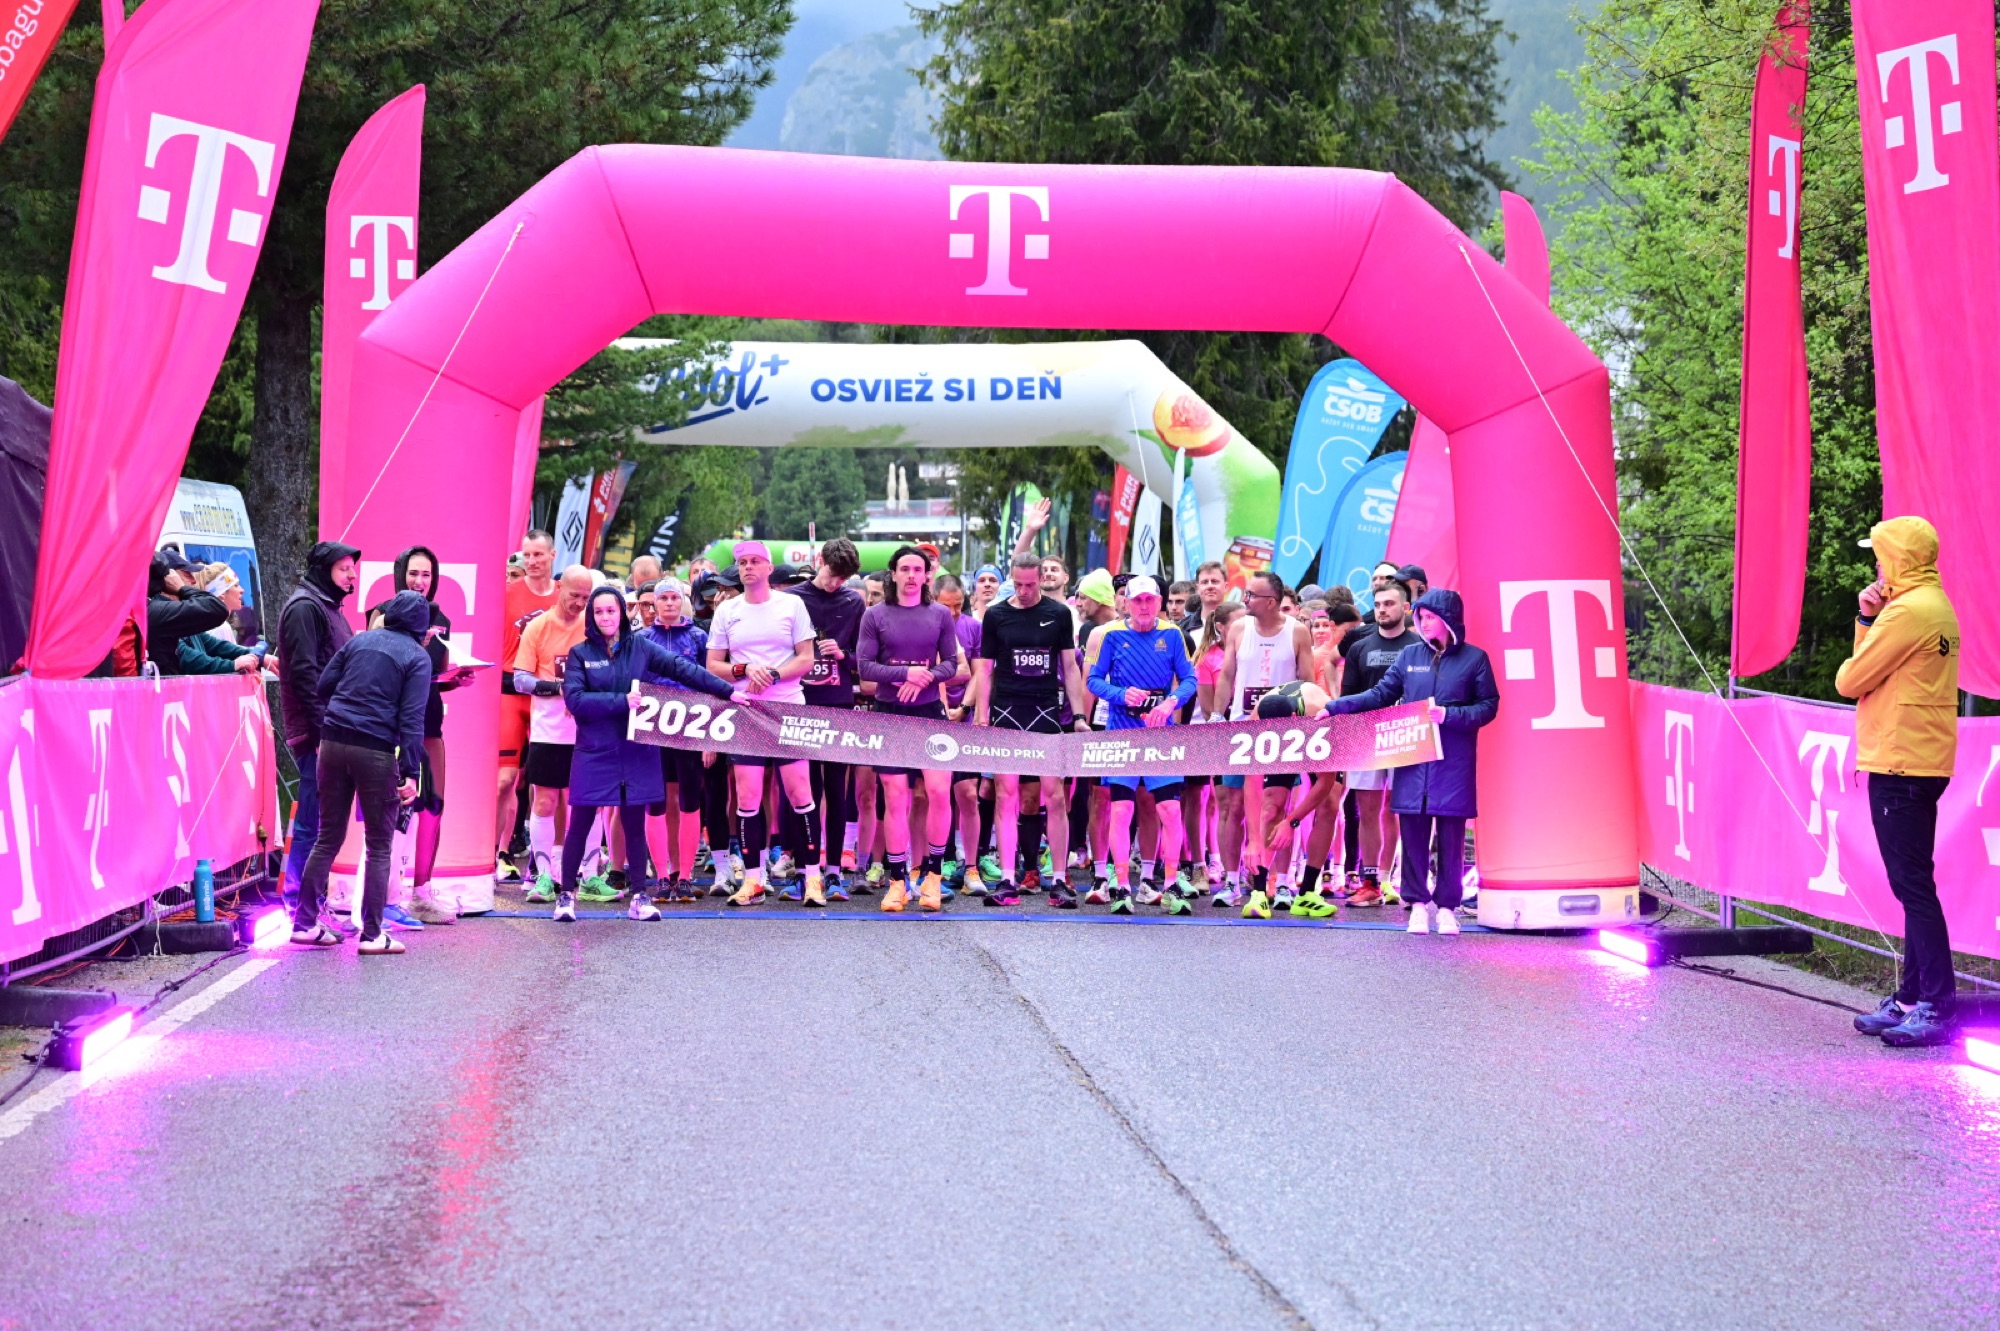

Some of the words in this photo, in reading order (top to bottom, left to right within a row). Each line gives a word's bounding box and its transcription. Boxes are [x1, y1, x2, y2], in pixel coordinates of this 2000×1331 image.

[1876, 33, 1962, 195] T
[138, 112, 276, 295] T
[949, 184, 1050, 296] T
[349, 215, 414, 311] T
[810, 372, 934, 402] OSVIEŽ
[943, 378, 975, 402] SI
[990, 370, 1062, 401] DEŇ
[1323, 393, 1383, 423] ČSOB
[1360, 497, 1396, 524] ČS
[1013, 654, 1043, 666] 1988
[1499, 579, 1617, 730] T
[809, 664, 829, 676] 95
[635, 696, 738, 741] 2026
[782, 715, 830, 729] TELEKOM
[1375, 715, 1420, 732] TELEKOM
[780, 725, 839, 745] NIGHT
[1082, 741, 1130, 750] TELEKOM
[1229, 726, 1331, 765] 2026
[1375, 724, 1430, 750] NIGHT
[962, 744, 1011, 757] GRAND
[1014, 749, 1046, 759] PRIX
[1082, 748, 1141, 762] NIGHT
